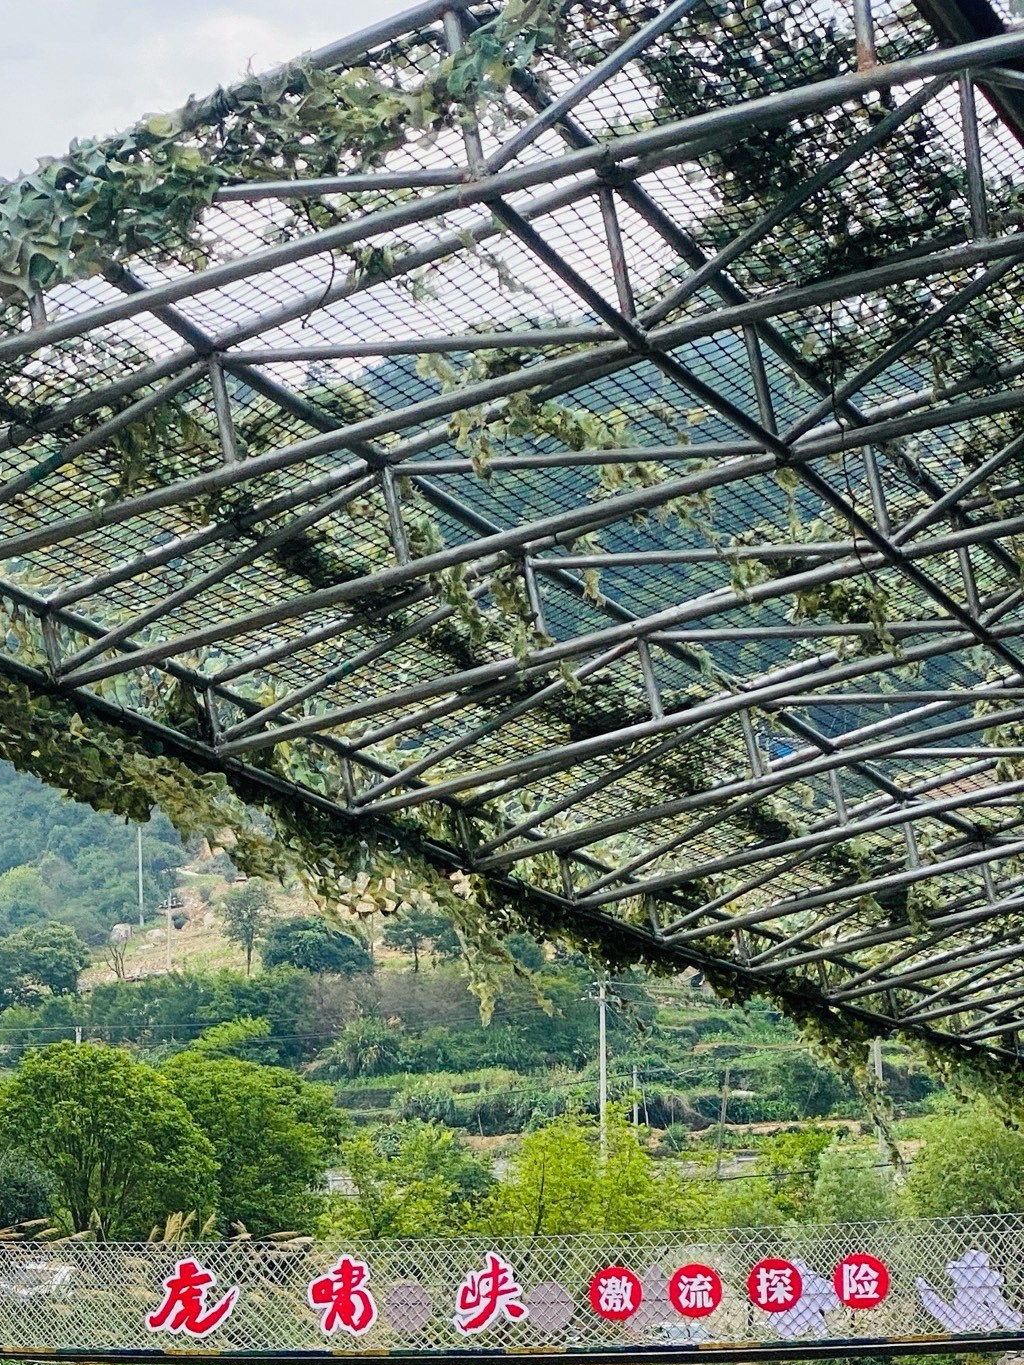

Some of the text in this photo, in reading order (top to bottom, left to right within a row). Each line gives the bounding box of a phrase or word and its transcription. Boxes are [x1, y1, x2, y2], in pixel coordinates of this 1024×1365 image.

[147, 1252, 880, 1336] 虎啸峡 激流探险
